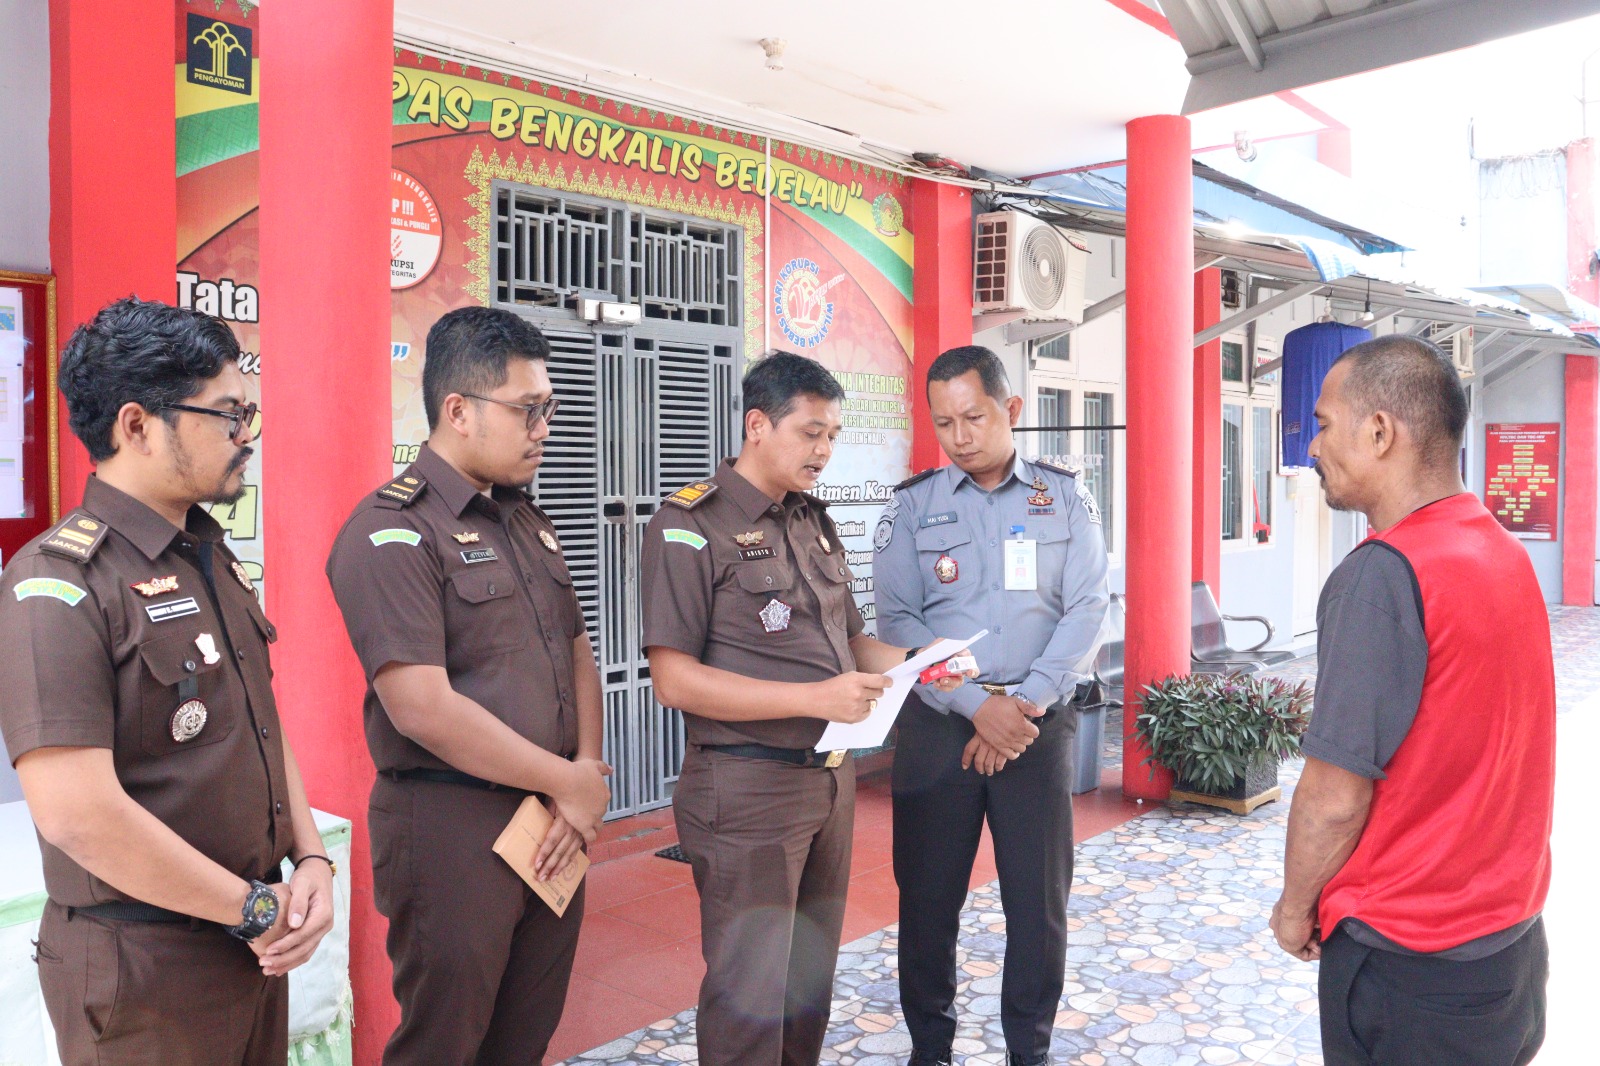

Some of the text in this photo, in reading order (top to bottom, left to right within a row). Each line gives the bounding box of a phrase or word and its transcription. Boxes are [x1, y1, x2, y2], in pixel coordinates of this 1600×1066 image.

[194, 72, 245, 89] PENGAYOMAN
[392, 71, 473, 132] PAS
[489, 97, 703, 183] BENGKALIS
[404, 178, 438, 223] BENGKALIS
[409, 220, 430, 231] PUNGLI
[391, 259, 414, 270] UPSI
[392, 270, 417, 278] EGRITAS
[779, 258, 819, 280] KORUPSI
[176, 270, 259, 323] Tata
[774, 279, 783, 315] DARI
[779, 317, 806, 347] BEBAS
[808, 303, 834, 347] WILAYAH
[829, 371, 904, 395] ONA INTEGRITAS
[841, 398, 905, 414] BAS DARI KORUPSI &
[841, 415, 909, 430] BERSIH DAN MELAYANI
[851, 432, 886, 445] BENGKALIS
[382, 489, 408, 500] JAKSA
[804, 480, 860, 501] itmen
[48, 539, 86, 555] JAKSA
